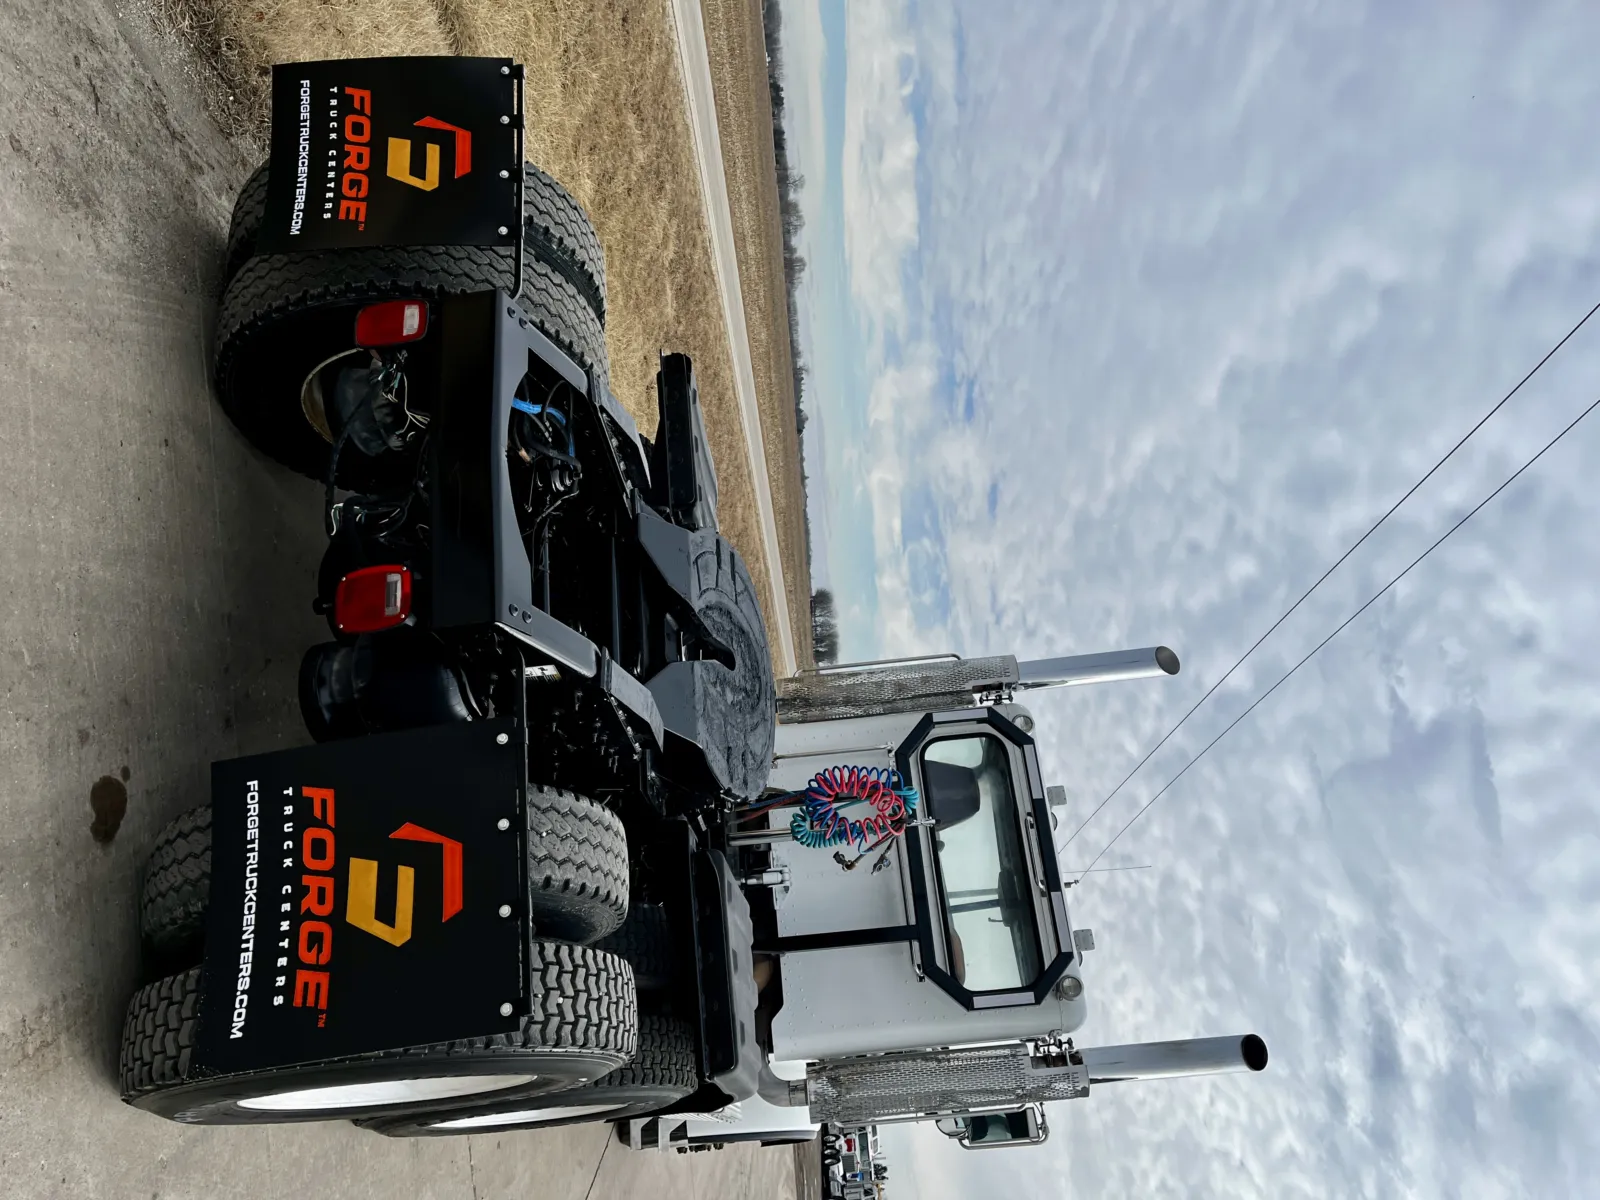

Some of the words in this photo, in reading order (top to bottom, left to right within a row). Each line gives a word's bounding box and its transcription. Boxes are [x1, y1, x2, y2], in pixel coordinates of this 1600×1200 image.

[289, 79, 311, 235] FORGETRUCKCENTERS.COM
[329, 86, 338, 140] TRUCK
[338, 86, 372, 221] FORGE
[322, 149, 337, 219] CENTERS
[282, 786, 294, 868] TRUCK
[229, 779, 259, 1039] FORGETRUCKCENTERS.COM
[272, 884, 292, 1007] CENTERS
[292, 786, 335, 1010] FORGE
